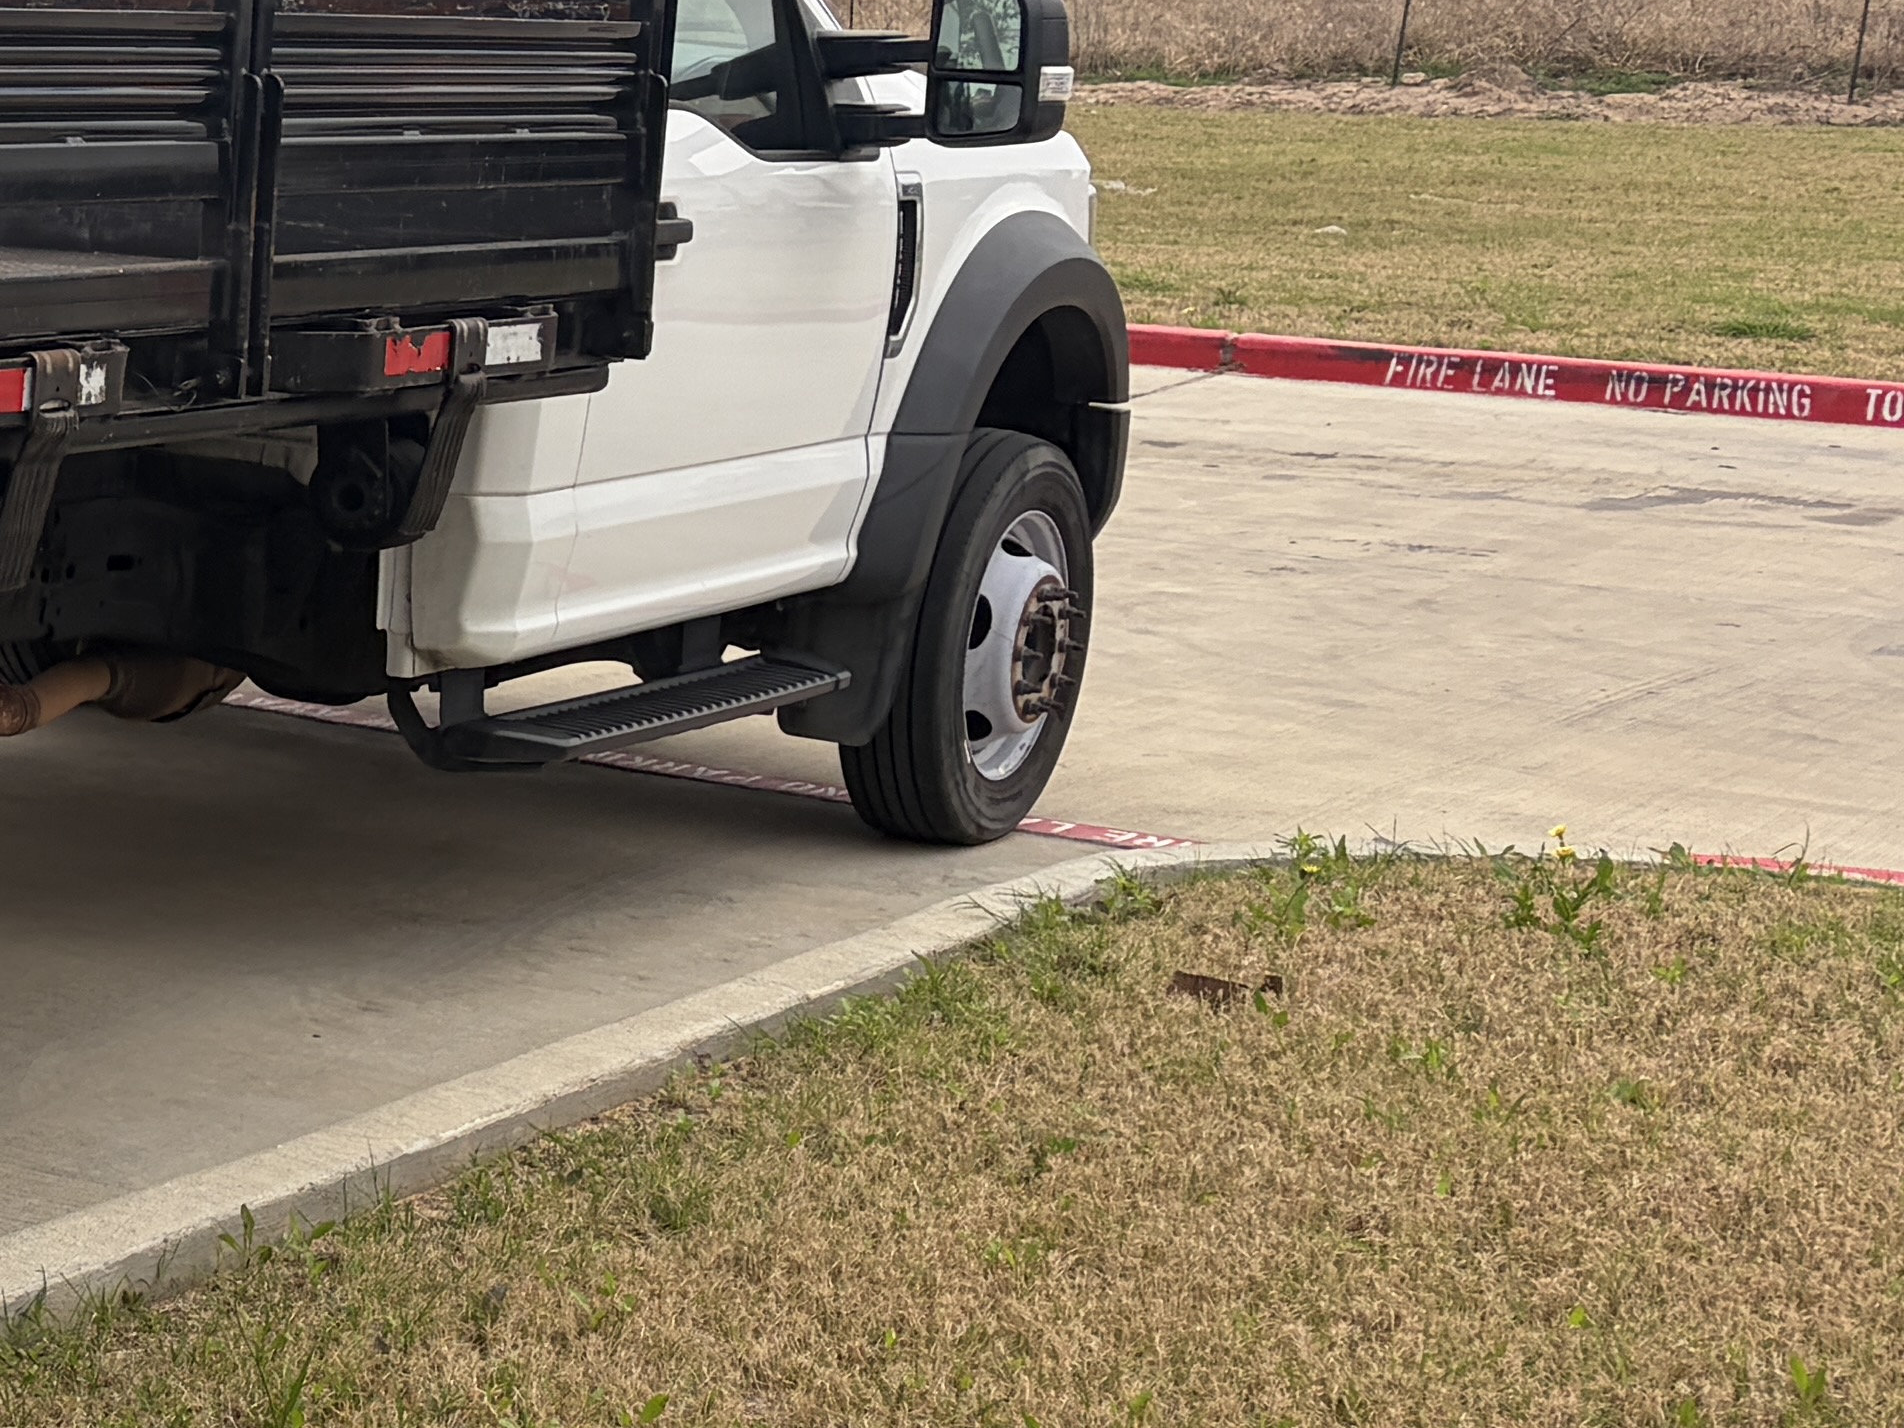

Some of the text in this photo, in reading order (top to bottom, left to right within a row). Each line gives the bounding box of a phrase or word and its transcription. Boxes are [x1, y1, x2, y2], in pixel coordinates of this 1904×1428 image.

[1383, 352, 1461, 388] FIRE
[1469, 359, 1559, 396] LANE
[1604, 369, 1650, 404] NO
[1663, 373, 1812, 418] PARKING
